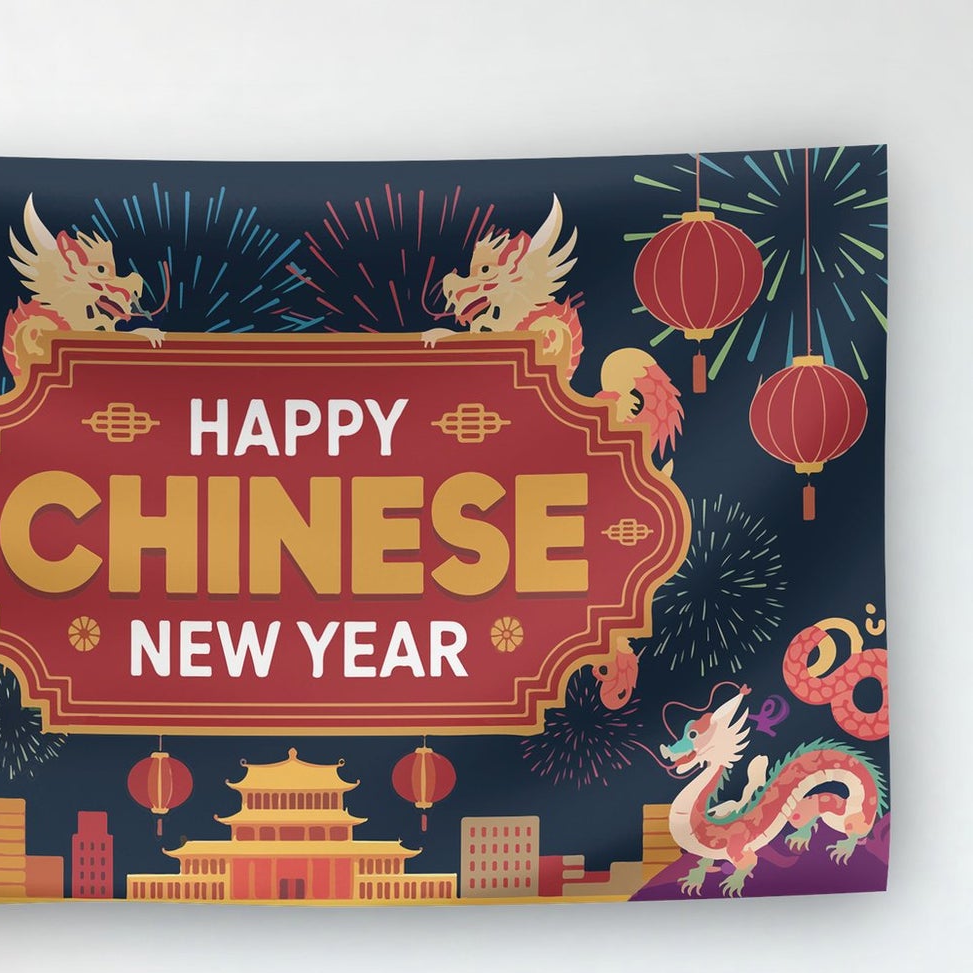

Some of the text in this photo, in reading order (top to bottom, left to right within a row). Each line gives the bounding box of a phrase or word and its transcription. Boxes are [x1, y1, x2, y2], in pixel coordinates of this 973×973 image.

[190, 398, 409, 457] HAPPY
[0, 470, 589, 598] CHINESE
[130, 619, 469, 679] NEW YEAR
